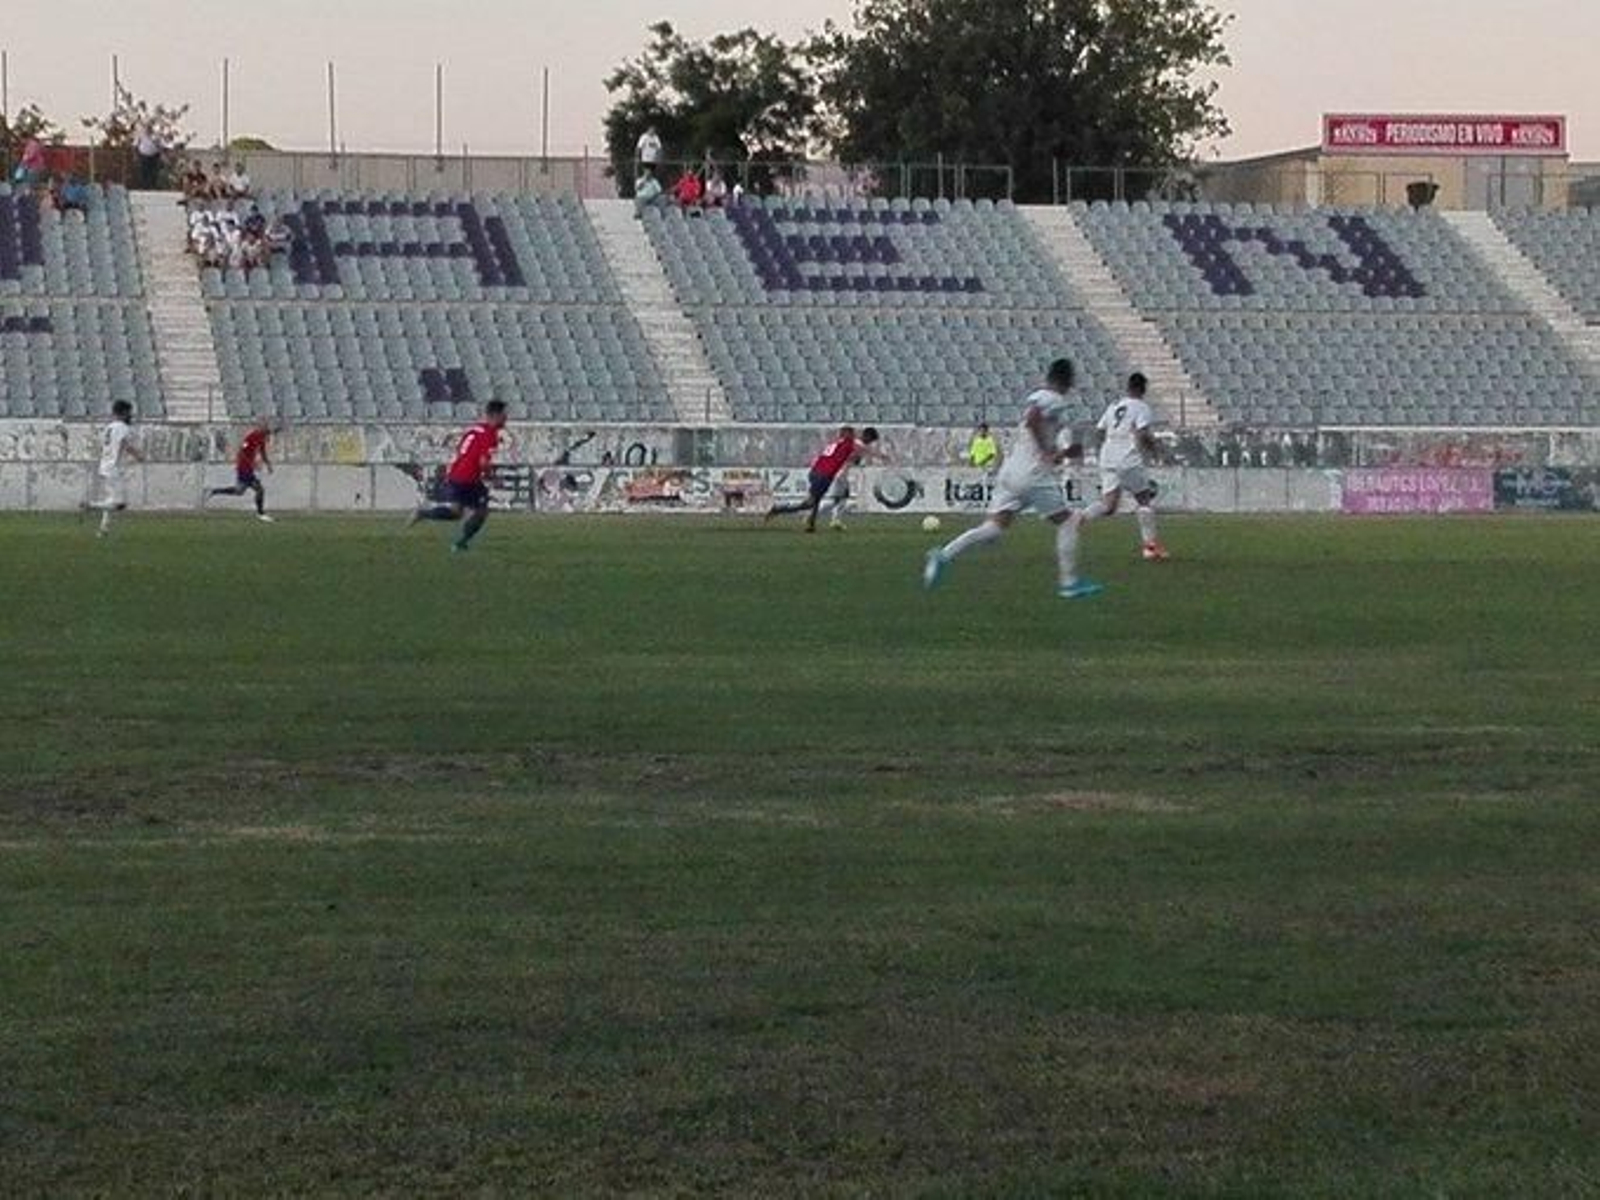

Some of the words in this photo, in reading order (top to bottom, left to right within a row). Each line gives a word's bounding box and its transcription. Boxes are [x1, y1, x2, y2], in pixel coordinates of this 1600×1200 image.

[1386, 122, 1456, 144] PERIODISMO
[1457, 122, 1474, 144] EN
[1476, 122, 1504, 144] VIVO
